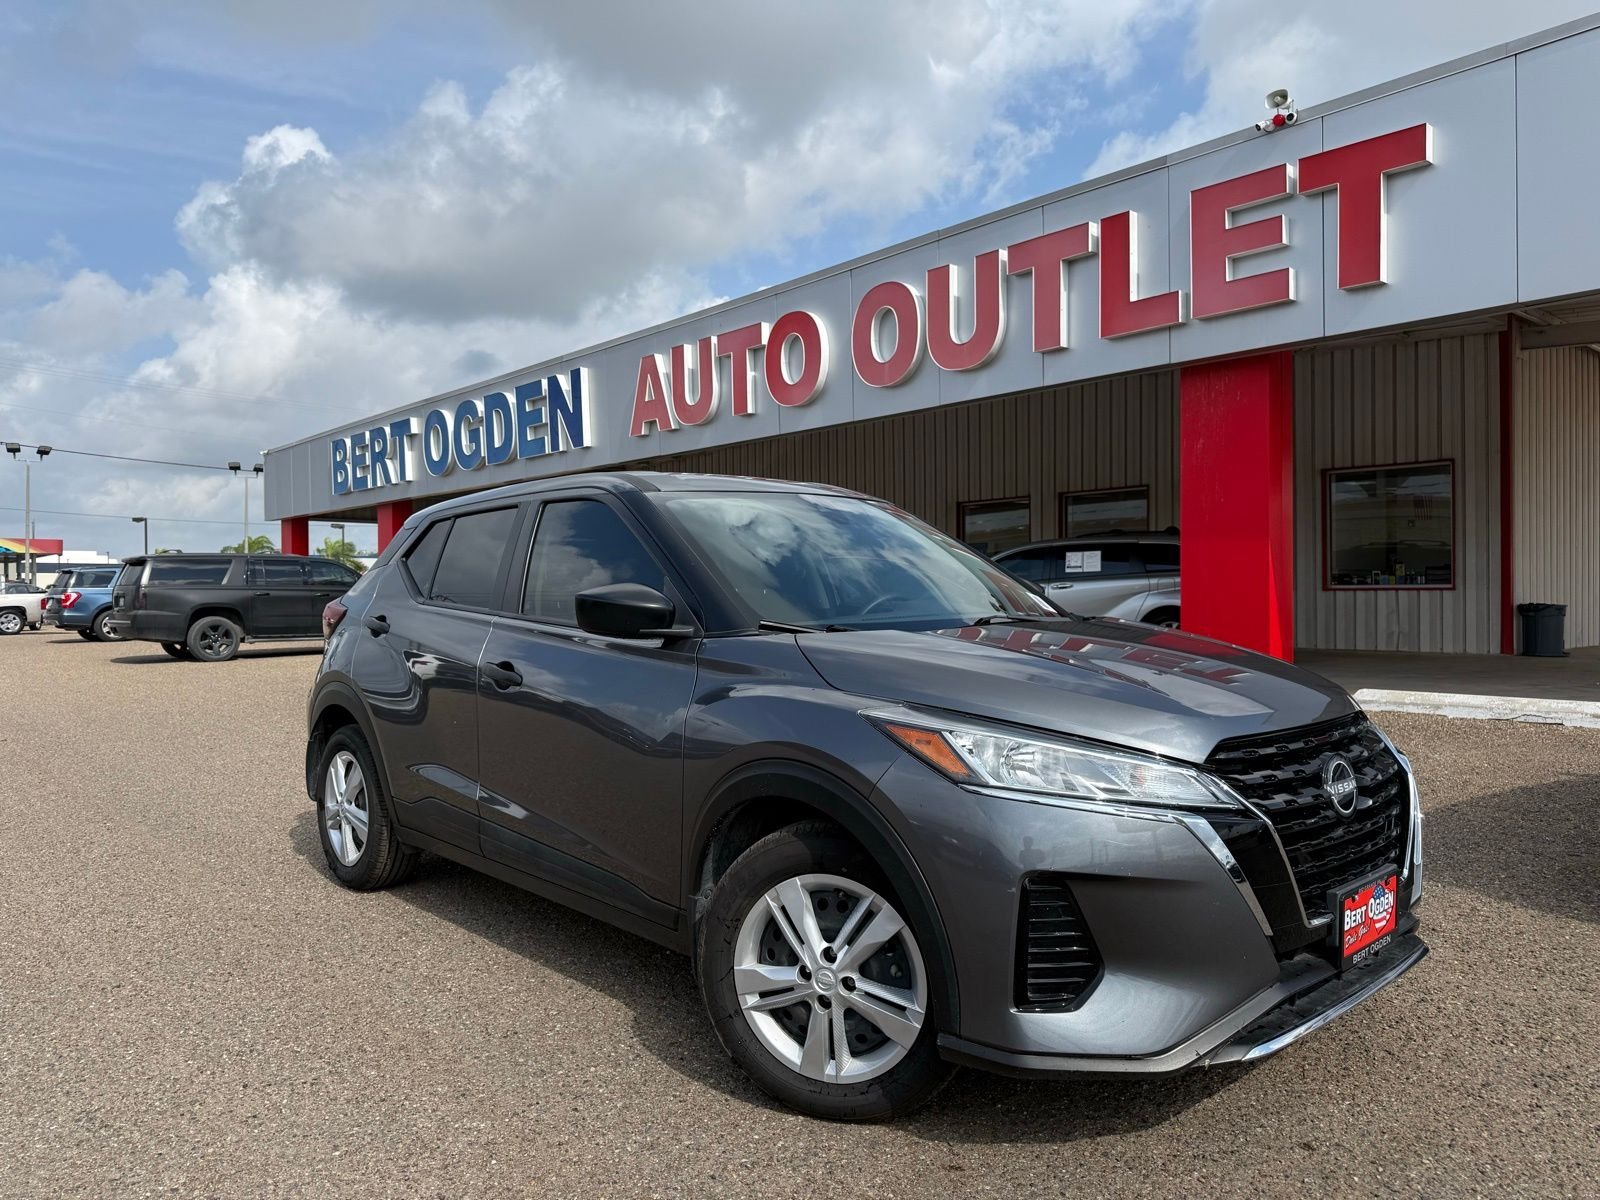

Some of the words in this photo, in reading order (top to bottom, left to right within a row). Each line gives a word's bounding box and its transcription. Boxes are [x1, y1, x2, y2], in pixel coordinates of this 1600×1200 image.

[331, 417, 418, 495] BERT
[423, 367, 592, 477] OGDEN
[629, 310, 829, 437] AUTO
[851, 122, 1434, 388] OUTLET
[1327, 779, 1357, 794] NISSAN
[1344, 905, 1367, 931] BERT
[1368, 890, 1394, 918] OGDEN
[1352, 948, 1370, 964] BERT
[1370, 934, 1391, 954] OGDEN
